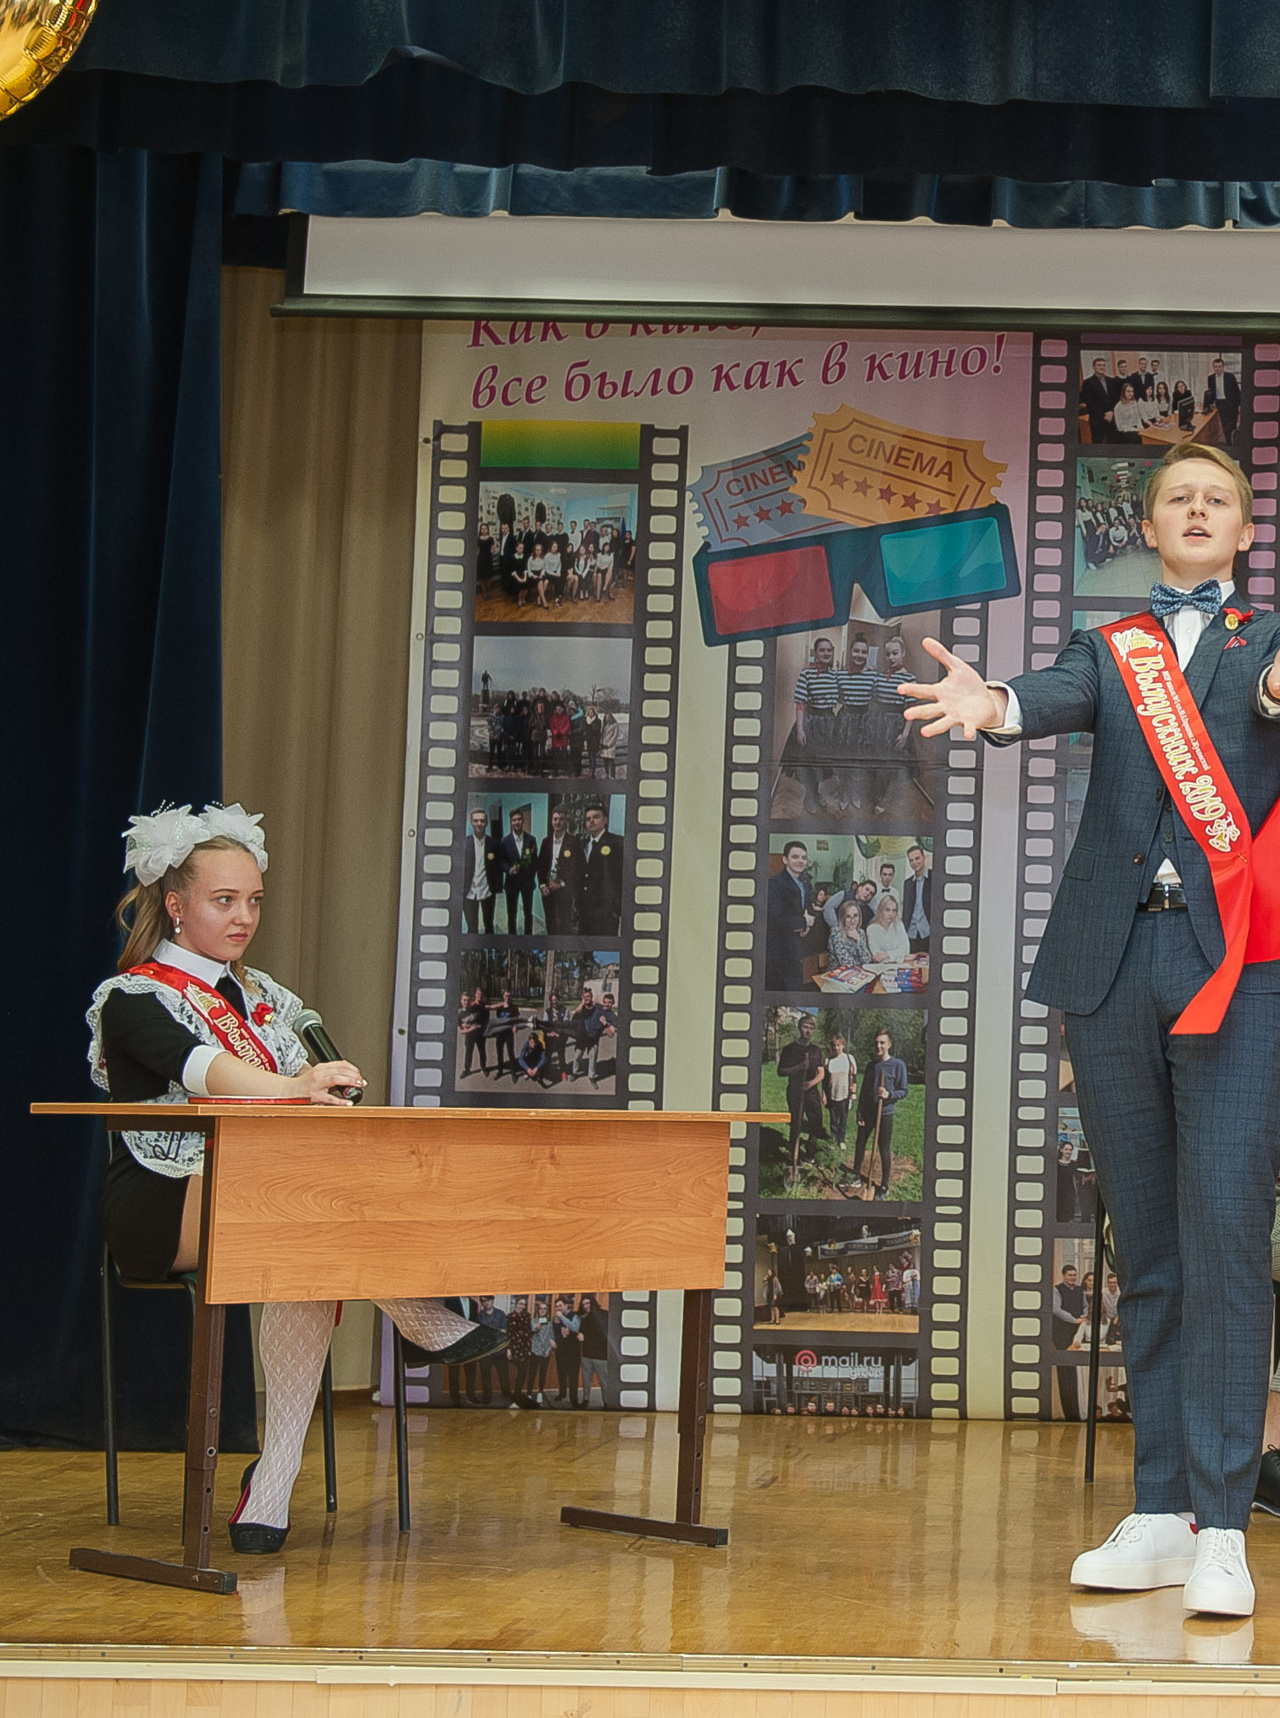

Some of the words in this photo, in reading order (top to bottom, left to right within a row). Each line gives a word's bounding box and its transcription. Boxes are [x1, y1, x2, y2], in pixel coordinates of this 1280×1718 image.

[471, 364, 549, 410] все
[563, 358, 694, 402] было
[710, 357, 804, 393] как
[820, 341, 850, 386] в
[863, 332, 1006, 383] кино!
[725, 459, 806, 497] CINEM
[846, 433, 954, 483] CINEMA
[1128, 653, 1199, 780] Выпускник
[1179, 774, 1226, 822] 2019
